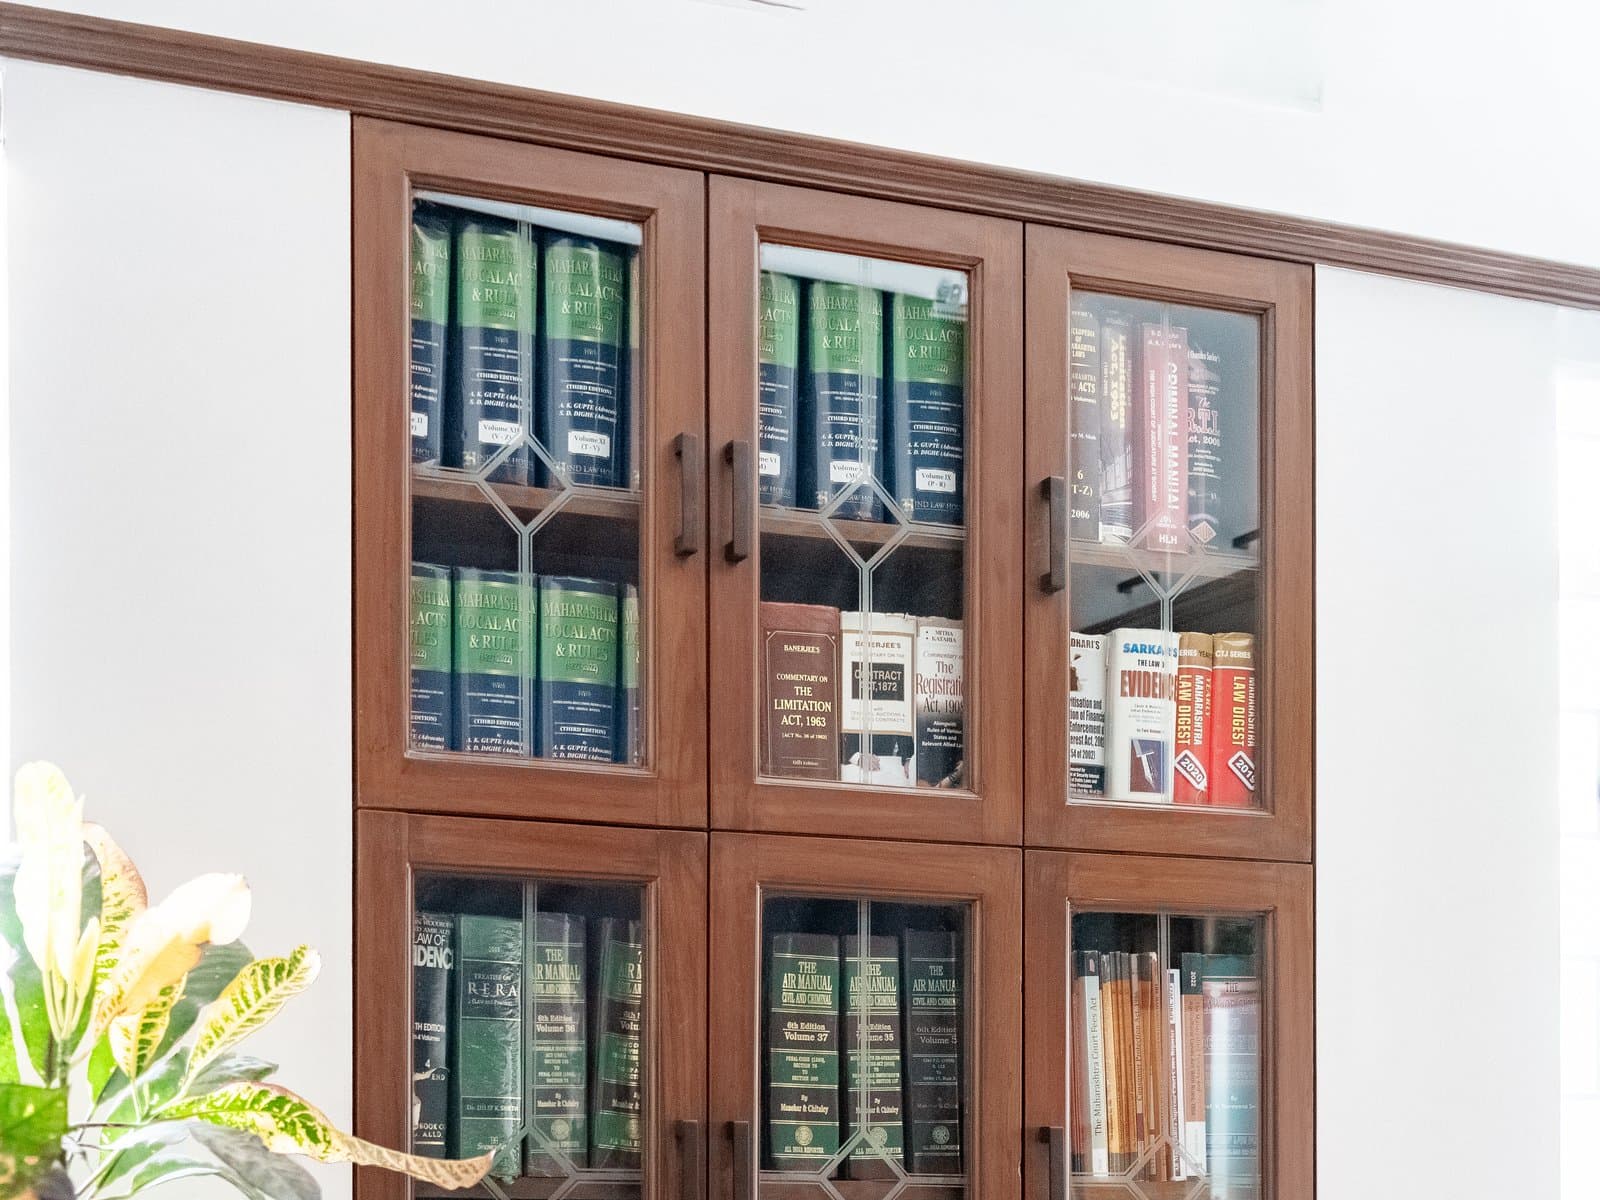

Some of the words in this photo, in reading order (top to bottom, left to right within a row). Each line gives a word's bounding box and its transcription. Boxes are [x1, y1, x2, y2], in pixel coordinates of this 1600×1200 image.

[908, 346, 917, 359] &
[1078, 381, 1096, 393] ACTS
[573, 403, 595, 411] GUPTE
[1109, 380, 1119, 422] 1963
[574, 411, 595, 419] DIGHE
[483, 424, 508, 433] Volume
[920, 442, 940, 450] GUPTE
[921, 449, 940, 457] DIGHE
[832, 464, 859, 472] Volume
[920, 472, 942, 480] Volume
[1076, 469, 1084, 480] 6
[1070, 509, 1091, 520] 2006
[1159, 534, 1178, 545] HLH
[469, 634, 481, 648] &
[556, 643, 566, 658] &
[1230, 650, 1252, 660] SERIES
[935, 660, 954, 674] The
[776, 673, 818, 682] COMMENTARY
[819, 674, 828, 683] ON
[794, 686, 813, 698] THE
[879, 682, 898, 691] 1872
[1178, 674, 1193, 702] LAW
[1233, 675, 1247, 703] LAW
[773, 699, 832, 713] LIMITATION
[923, 697, 941, 714] Act,
[1193, 674, 1205, 745] MAHARASHTRA
[781, 715, 803, 727] ACT,
[806, 716, 827, 728] 1963
[1177, 706, 1191, 746] DIGEST
[1231, 707, 1245, 747] DIGEST
[567, 745, 588, 753] GUPTE
[1181, 756, 1204, 782] 2020
[433, 935, 447, 946] OF
[545, 949, 564, 961] THE
[545, 963, 580, 980] MANUAL
[798, 961, 817, 974] THE
[928, 965, 944, 976] THE
[782, 973, 797, 988] AIR
[797, 974, 833, 991] MANUAL
[912, 979, 927, 992] AIR
[1225, 983, 1240, 993] THE
[782, 992, 796, 1004] CIVIL
[796, 993, 807, 1004] AND
[808, 993, 833, 1006] CRIMINAL
[1088, 997, 1097, 1012] Act
[424, 1023, 446, 1033] EDITION
[536, 1024, 563, 1033] Volume
[787, 1021, 798, 1029] 6th
[800, 1022, 826, 1031] Edition
[1089, 1012, 1098, 1034] Fees
[784, 1031, 815, 1042] Volume
[817, 1032, 829, 1042] 37
[885, 1033, 895, 1042] 35
[920, 1036, 949, 1045] Volume
[1090, 1035, 1099, 1060] Court
[1133, 1025, 1143, 1063] Protection
[425, 1058, 432, 1069] 4
[1091, 1061, 1102, 1118] Maharashtra
[1093, 1118, 1103, 1137] The
